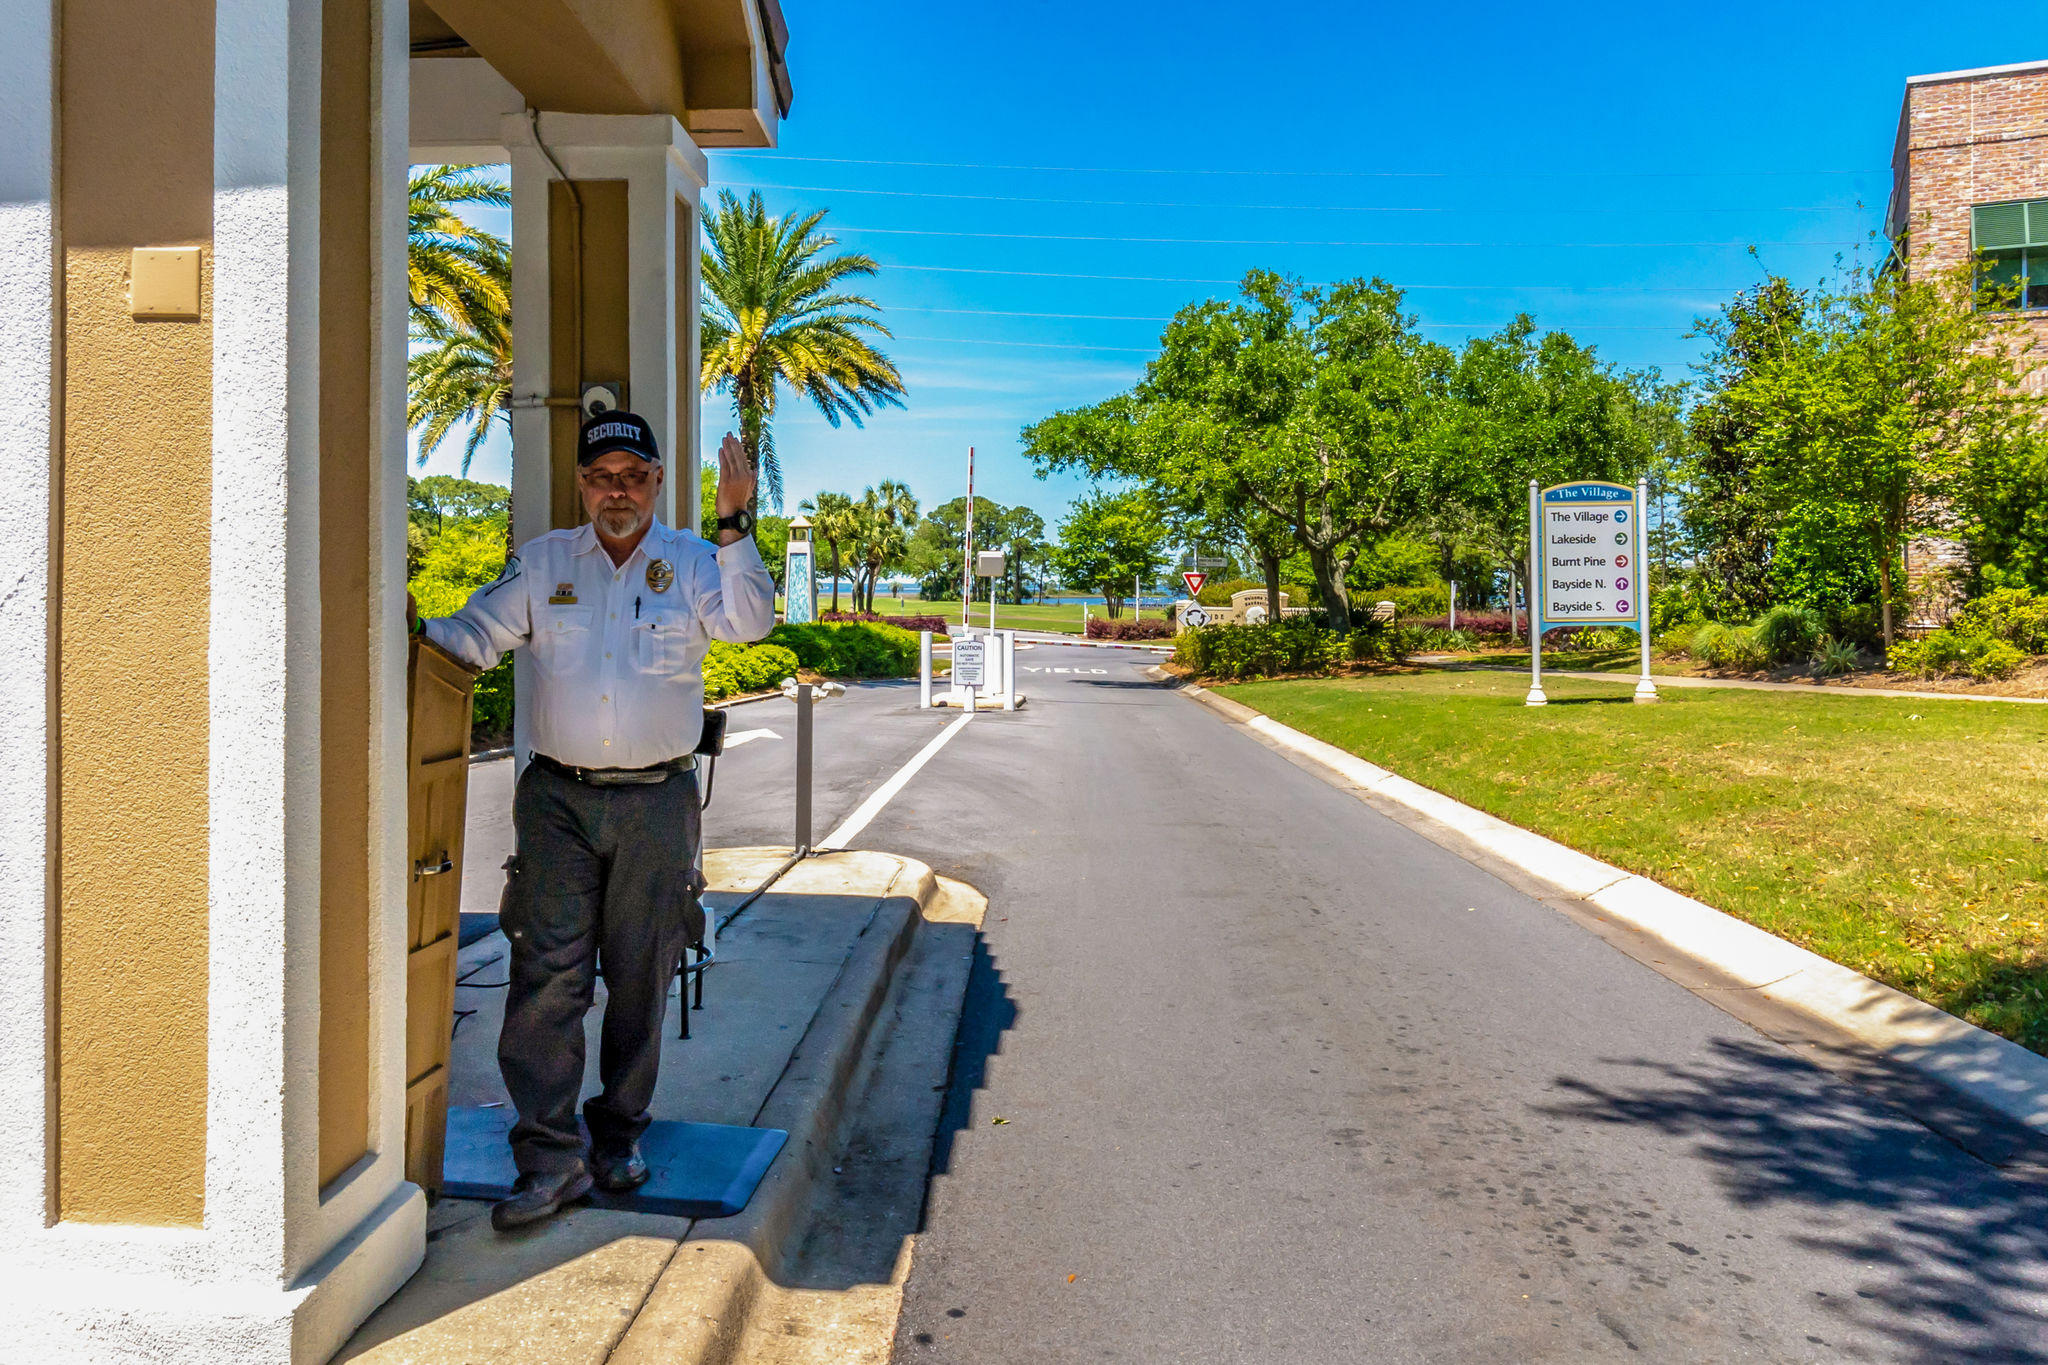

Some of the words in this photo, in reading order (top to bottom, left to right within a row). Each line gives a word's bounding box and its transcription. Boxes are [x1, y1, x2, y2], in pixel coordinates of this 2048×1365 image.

[587, 422, 641, 444] SECURITY
[1556, 489, 1578, 499] The
[1581, 487, 1619, 500] Village
[1550, 512, 1571, 522] The
[1573, 512, 1609, 523] Village
[1551, 534, 1597, 544] Lakeside
[1552, 557, 1581, 567] Burnt
[1584, 556, 1606, 567] Pine
[1552, 579, 1592, 591] Bayside
[1595, 579, 1607, 589] N.
[1553, 601, 1593, 613] Bayside
[1596, 602, 1605, 611] S.
[1022, 666, 1108, 675] YIELD
